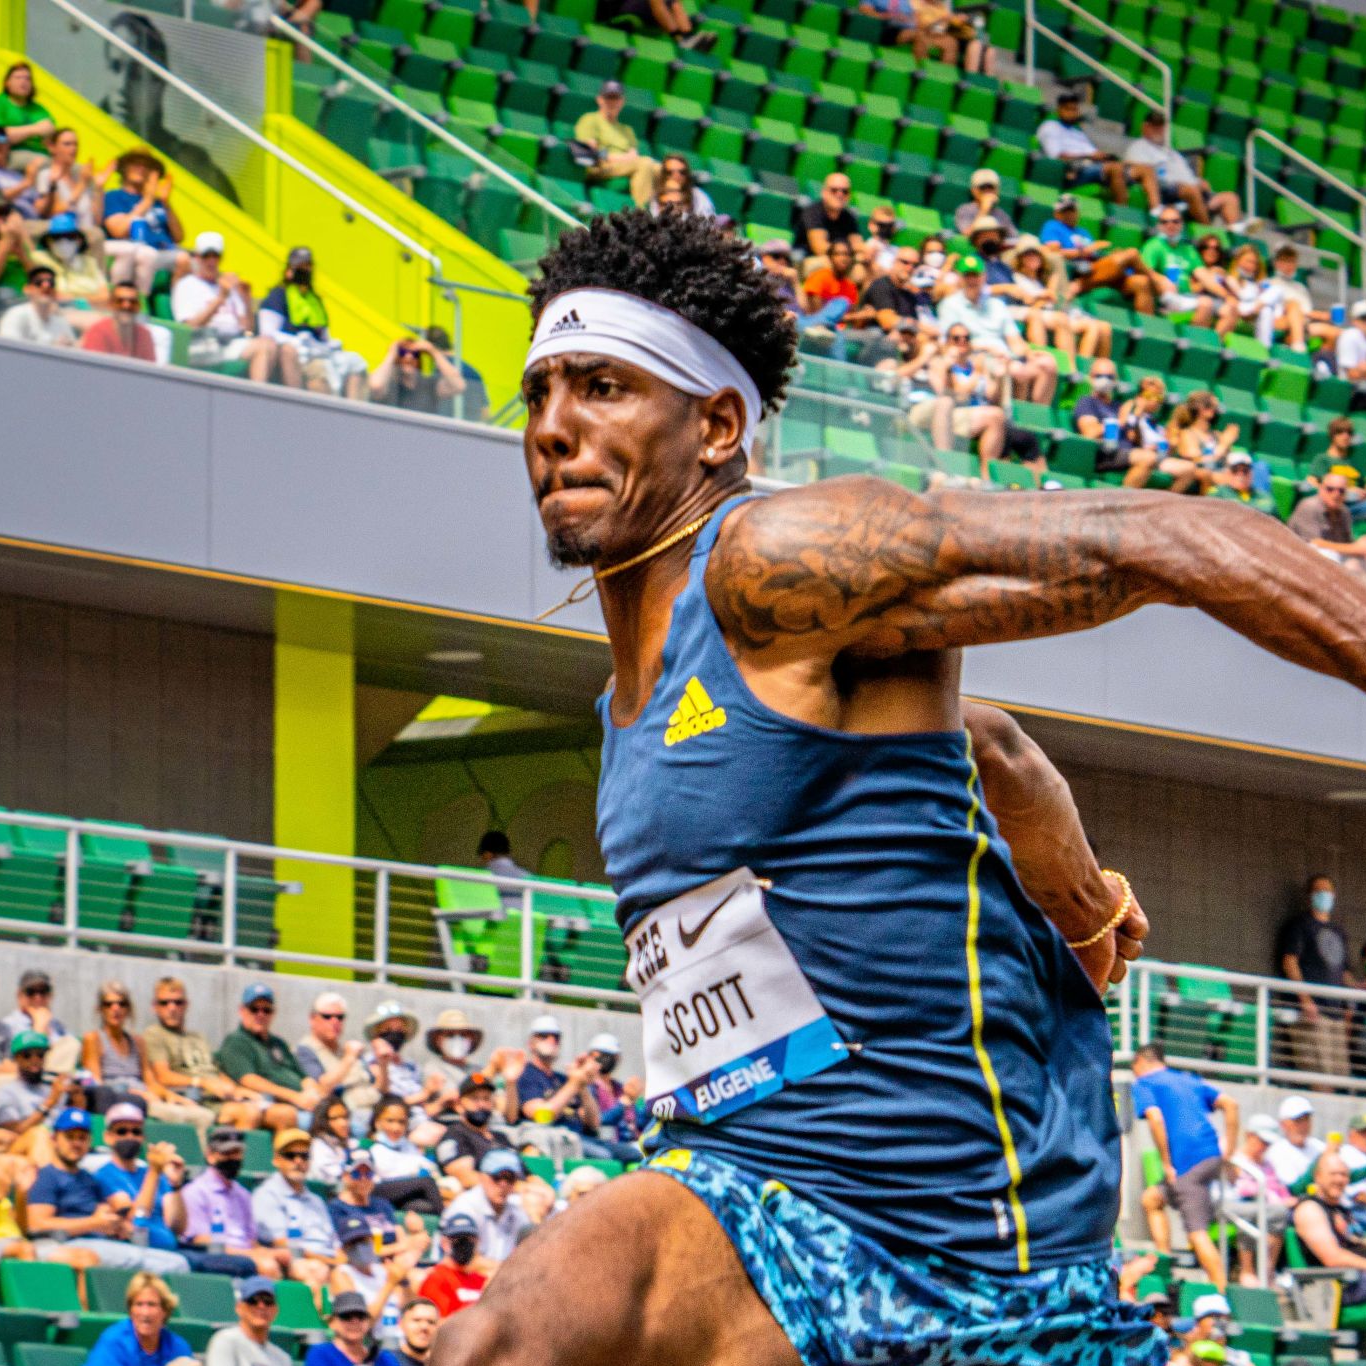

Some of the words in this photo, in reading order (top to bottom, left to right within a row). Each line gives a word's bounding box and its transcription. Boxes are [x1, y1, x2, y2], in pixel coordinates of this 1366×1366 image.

[664, 706, 727, 747] adidas
[663, 972, 755, 1055] SCOTT
[695, 1056, 777, 1113] EUGENE
